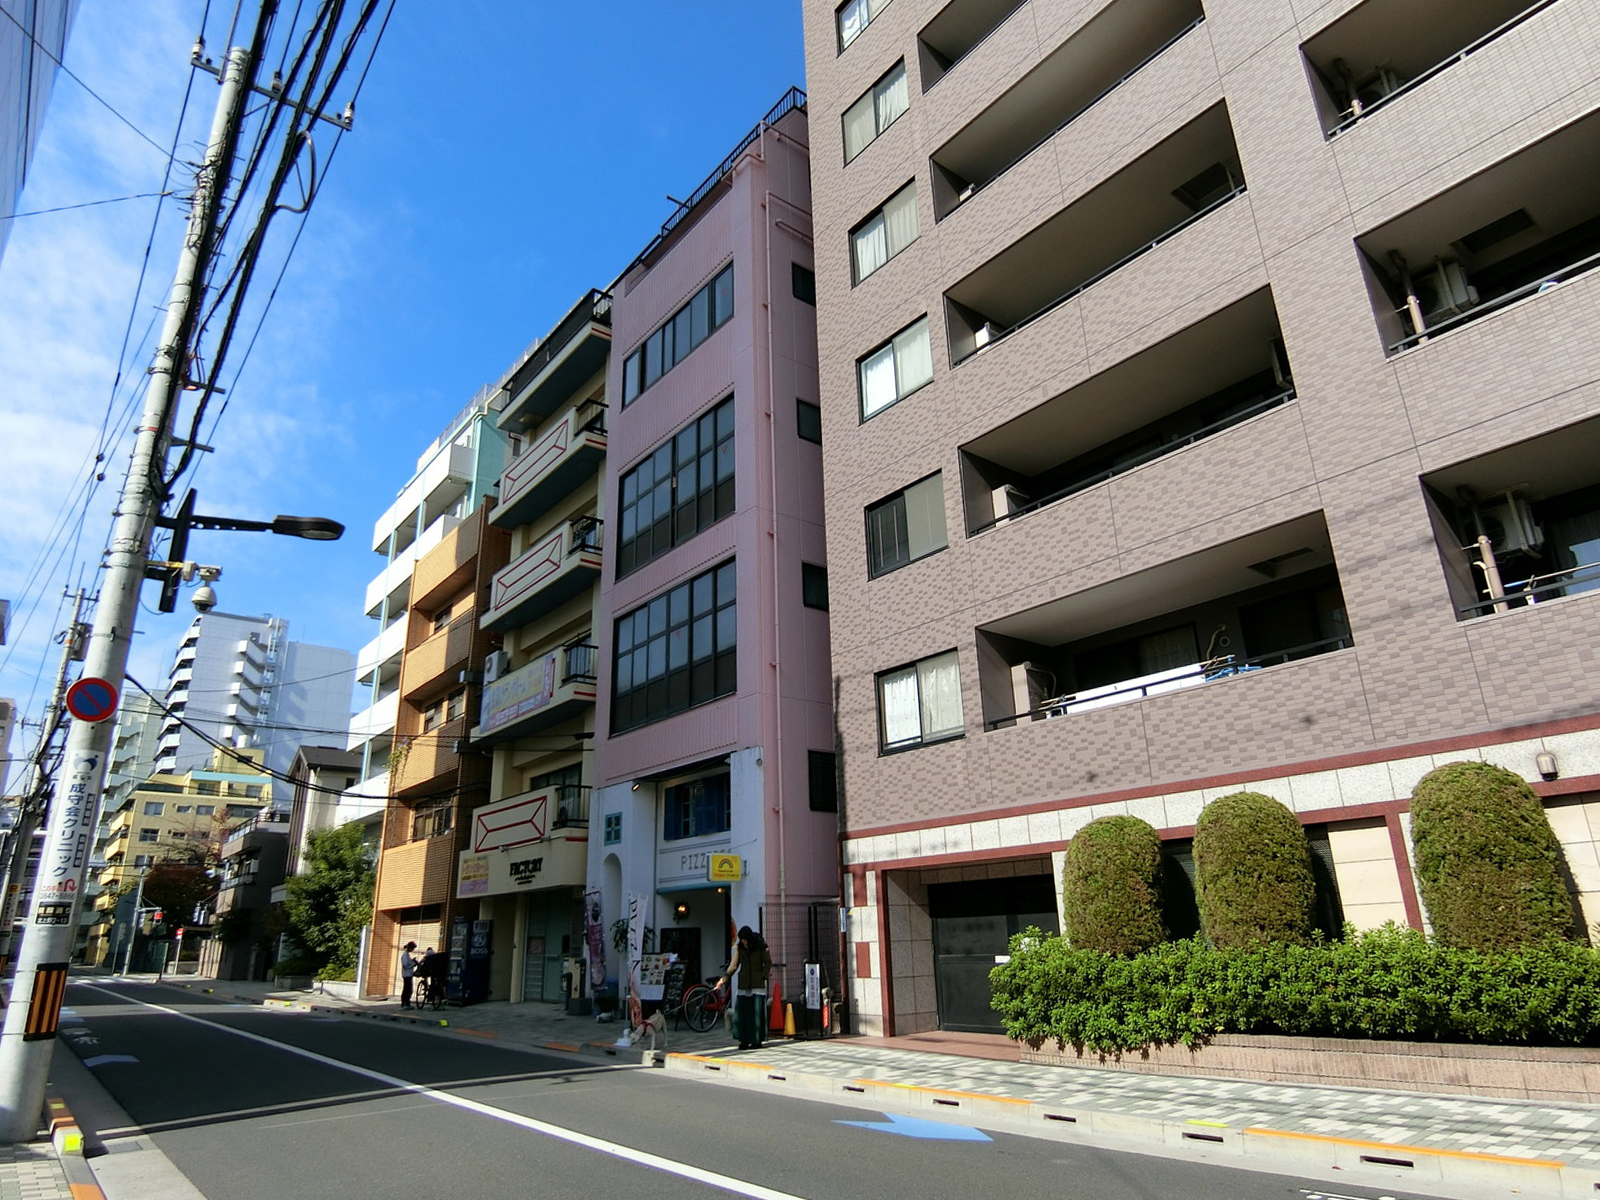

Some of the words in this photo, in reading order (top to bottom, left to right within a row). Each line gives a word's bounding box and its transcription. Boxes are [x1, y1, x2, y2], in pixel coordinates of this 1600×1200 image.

[53, 783, 87, 877] 成守会クリニック
[509, 857, 544, 876] FACTORY
[470, 947, 488, 955] BOSS
